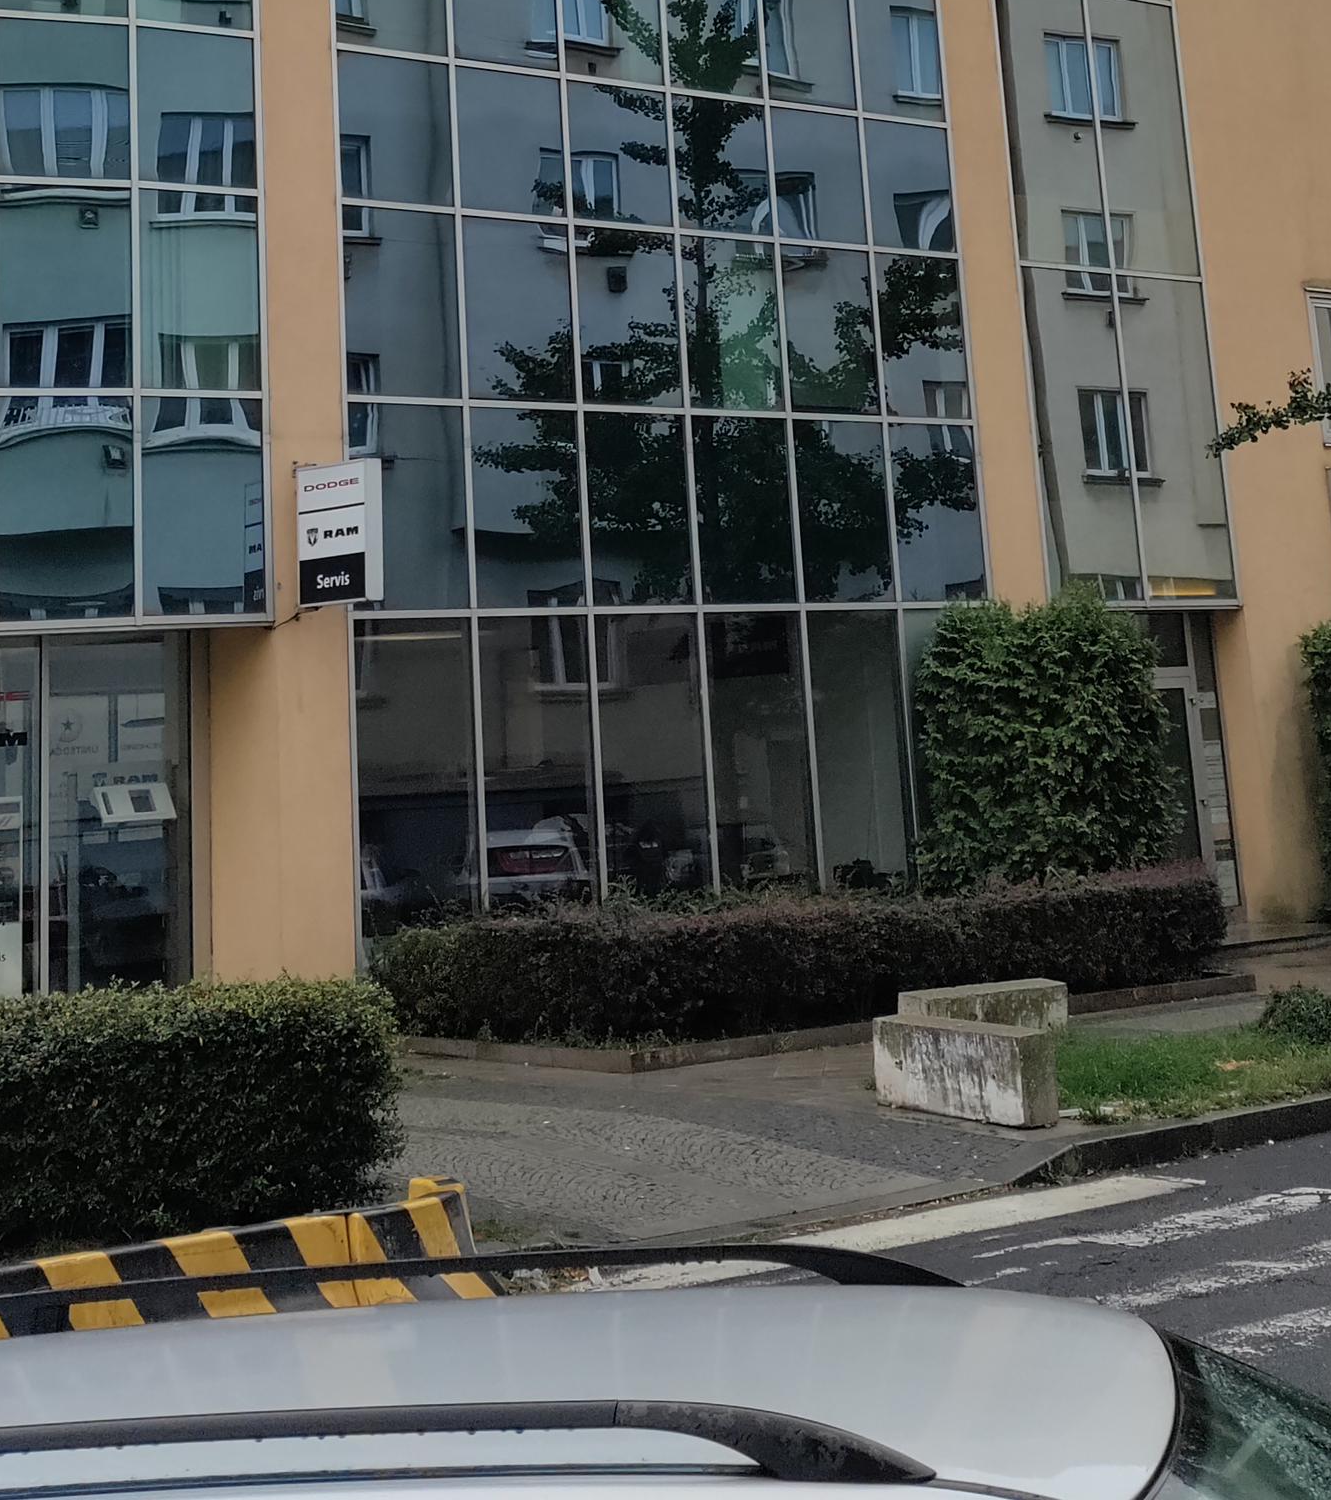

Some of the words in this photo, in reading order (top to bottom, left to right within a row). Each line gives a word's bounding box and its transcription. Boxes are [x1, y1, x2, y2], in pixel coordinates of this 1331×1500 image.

[304, 477, 360, 493] DODGE
[323, 525, 359, 540] RAM
[316, 571, 350, 589] Servis
